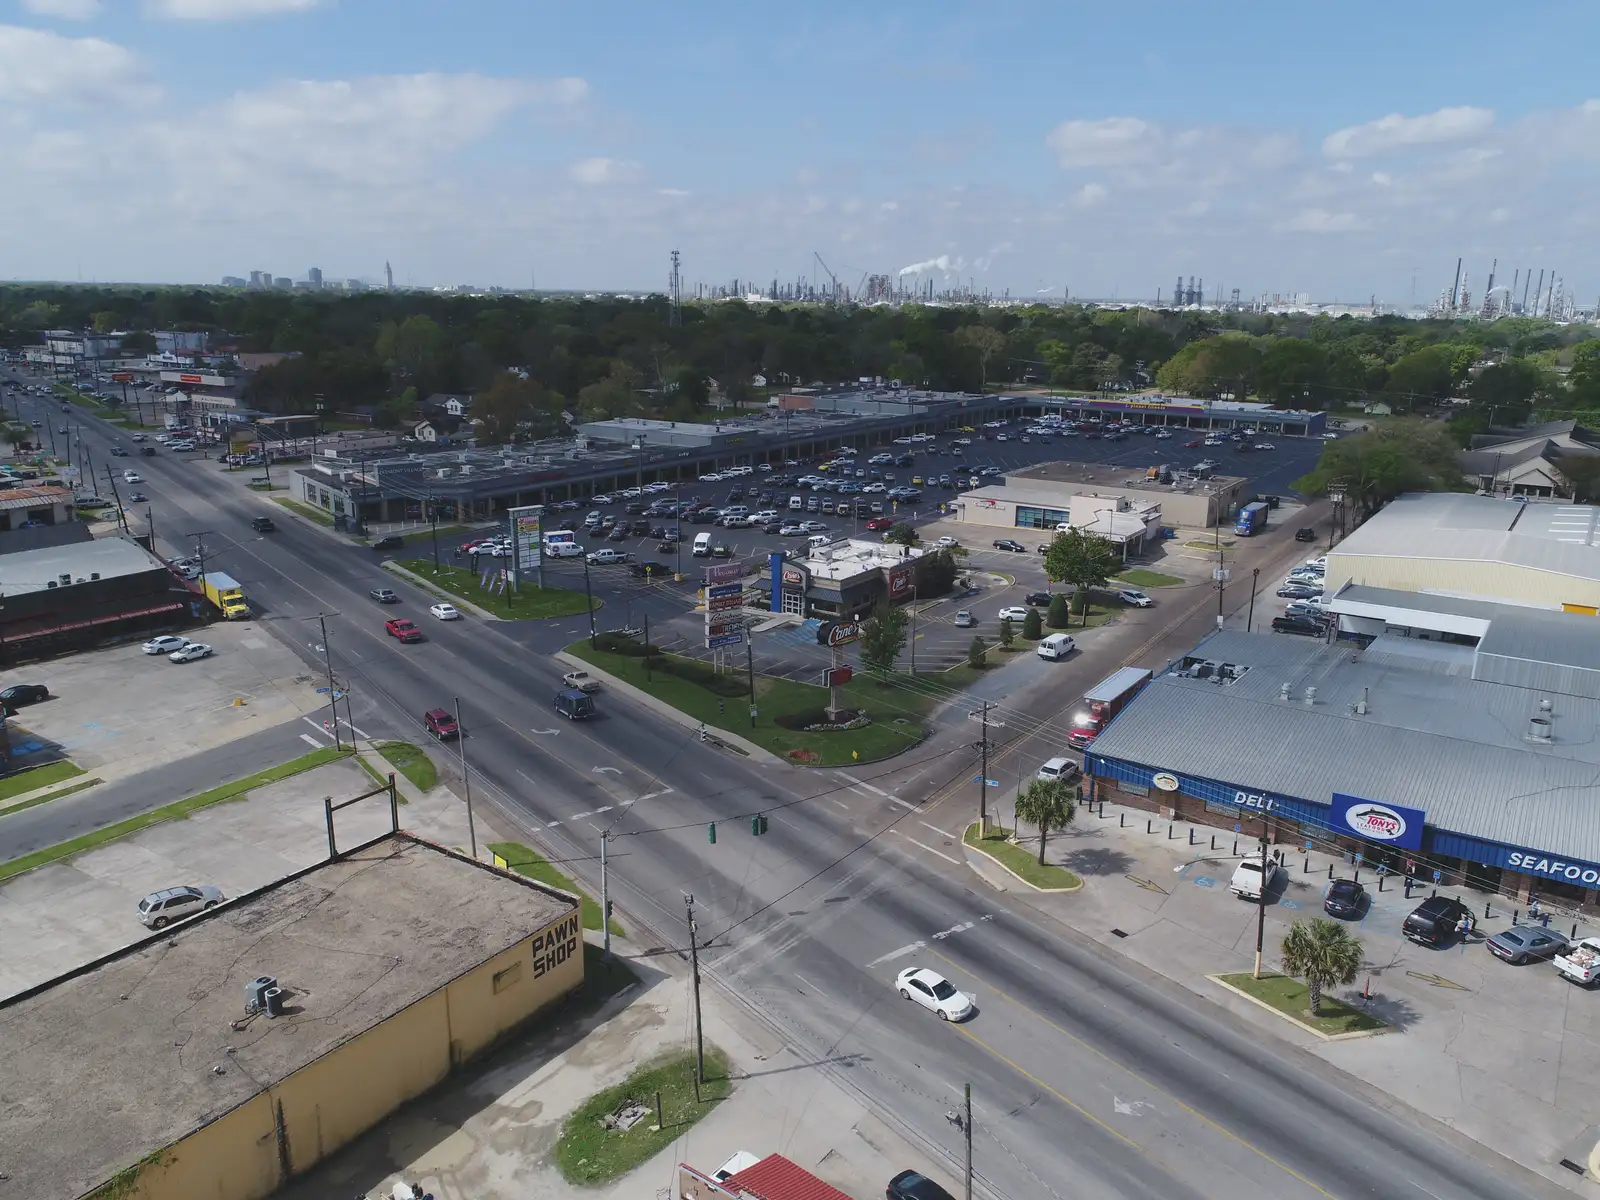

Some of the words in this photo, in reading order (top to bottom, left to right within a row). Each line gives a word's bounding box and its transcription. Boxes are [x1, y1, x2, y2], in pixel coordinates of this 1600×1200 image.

[828, 620, 860, 647] Cane's
[1235, 791, 1273, 810] DELI
[1356, 822, 1385, 832] SEAFOOD
[1508, 852, 1600, 885] SEAFOO
[532, 915, 578, 958] PAWN
[533, 937, 577, 980] SHOP
